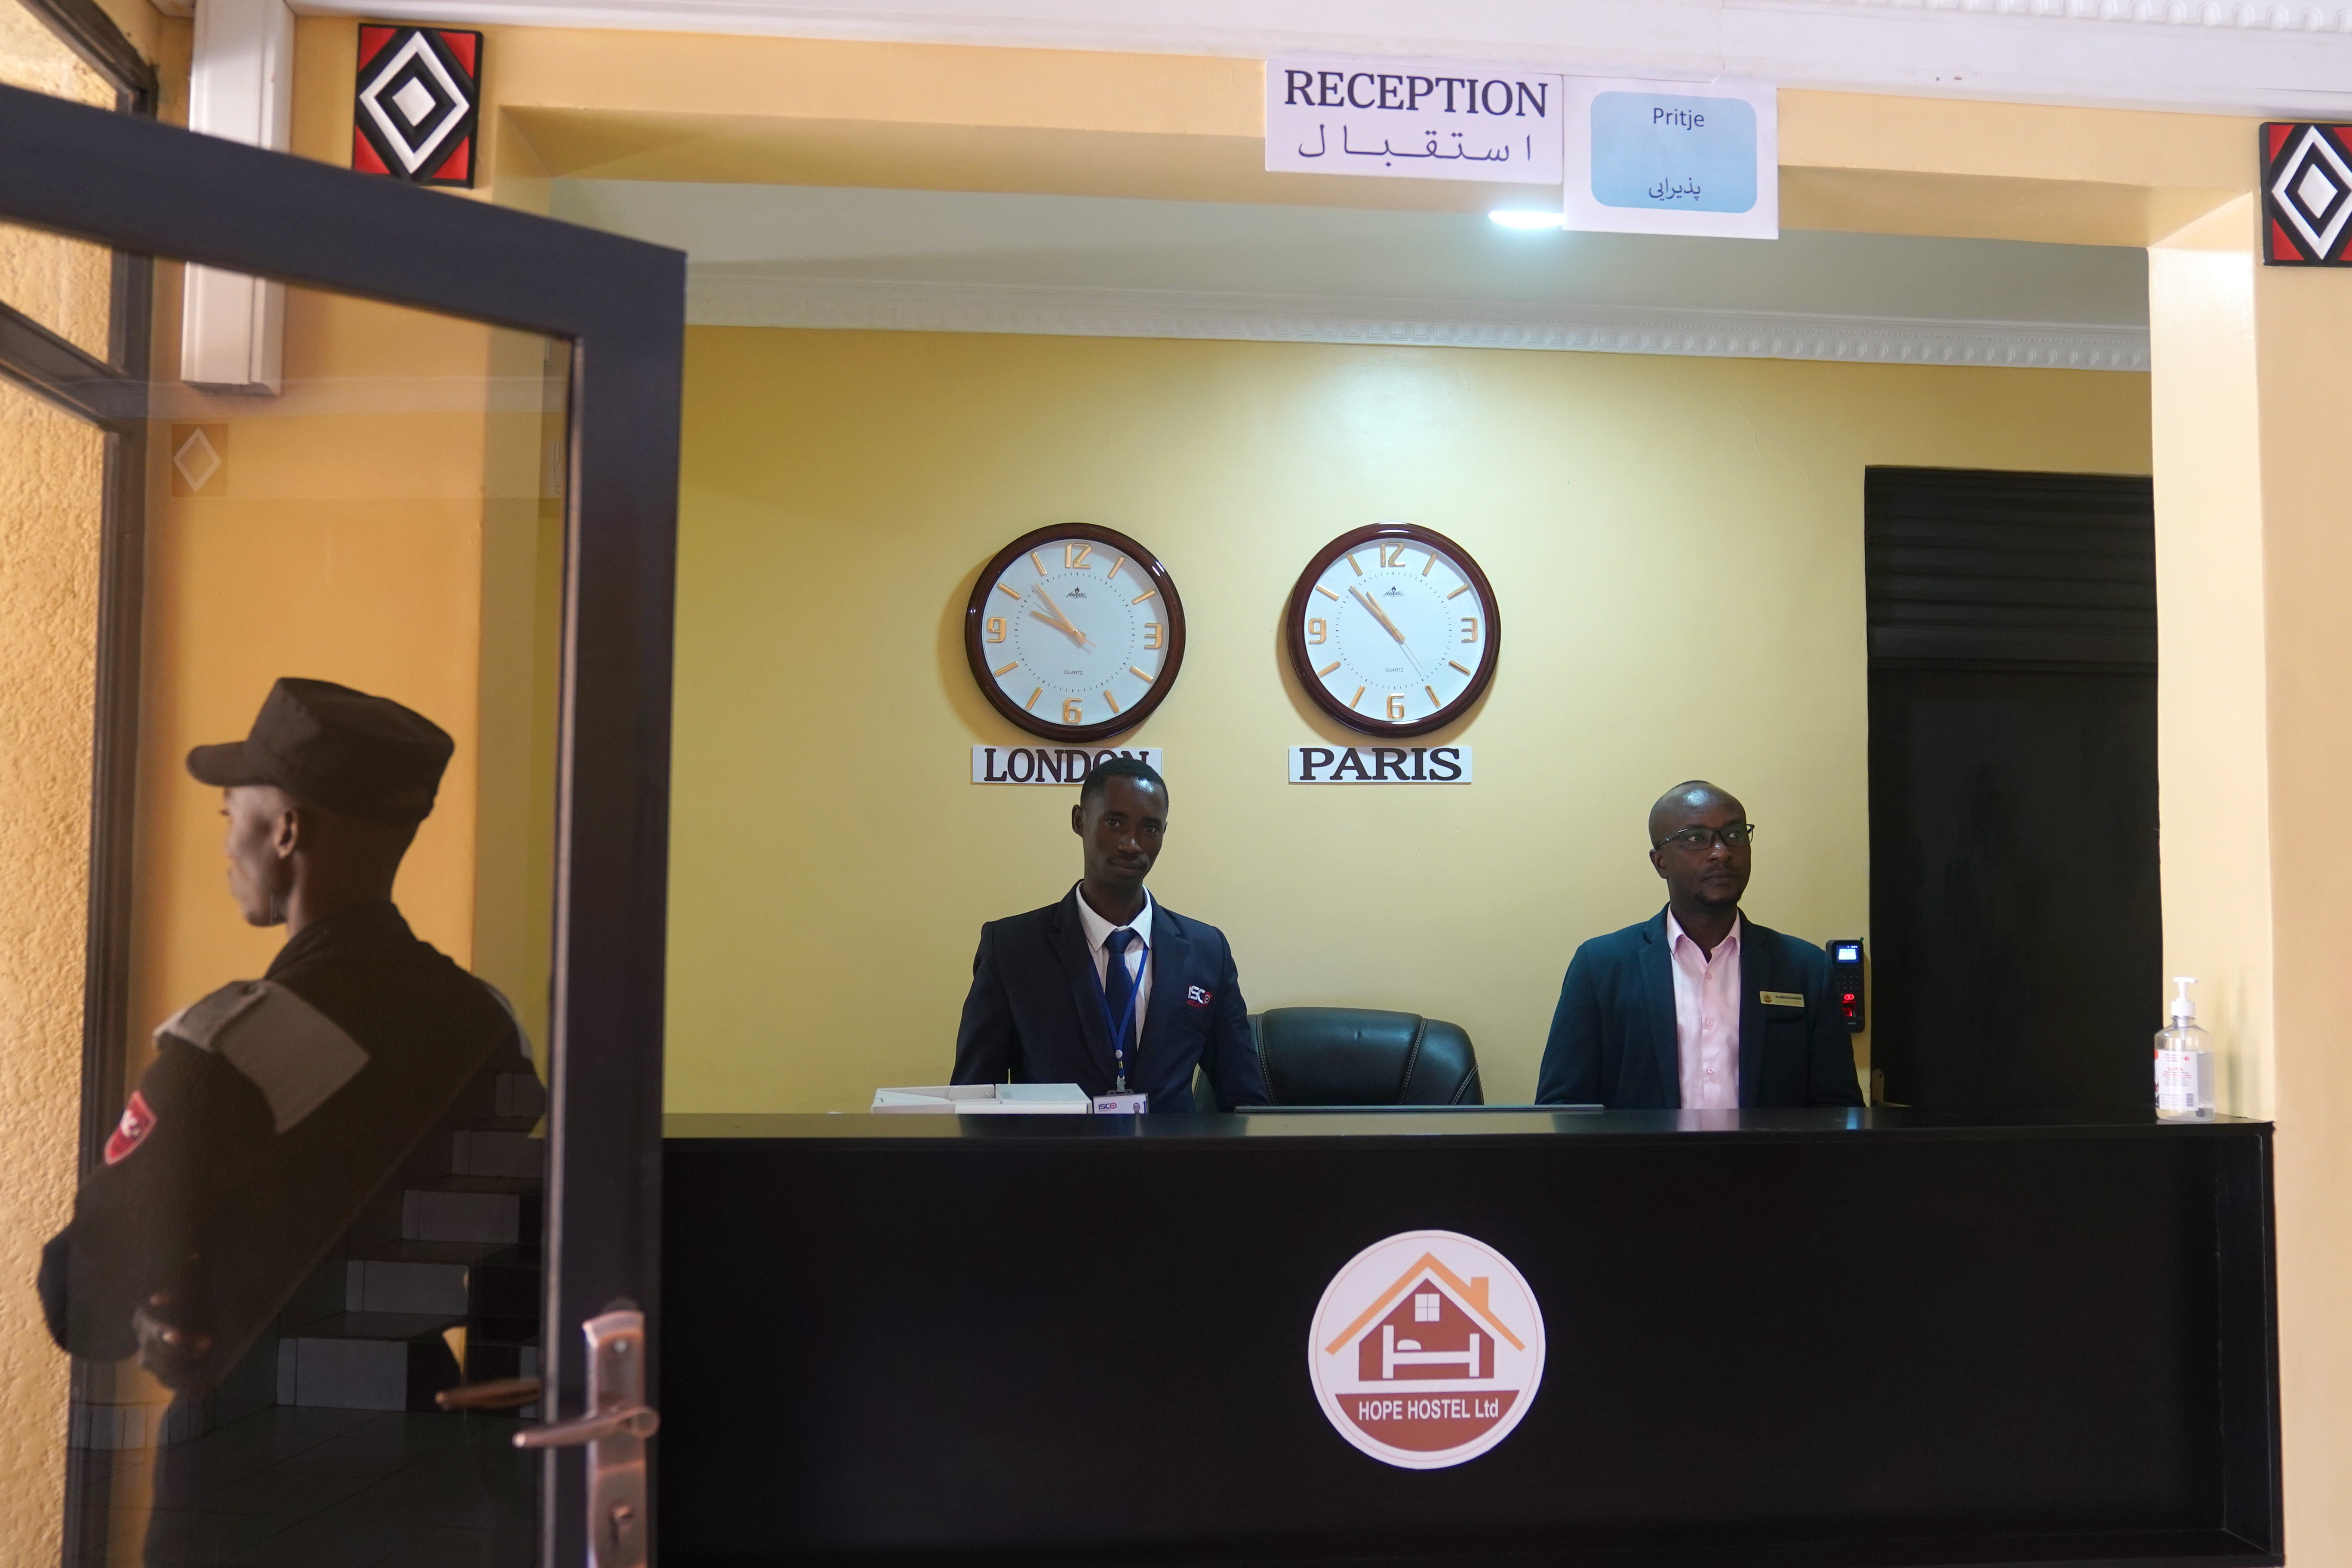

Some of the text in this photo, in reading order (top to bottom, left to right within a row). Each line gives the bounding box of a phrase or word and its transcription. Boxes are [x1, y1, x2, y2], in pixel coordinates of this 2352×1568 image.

[1284, 70, 1548, 117] RECEPTION
[1653, 108, 1705, 130] Pritje
[1298, 123, 1531, 167] استقبال
[1648, 177, 1701, 201] پذیرایی
[1064, 543, 1092, 569] 12
[1379, 542, 1406, 568] 12
[987, 617, 1007, 643] 9
[1144, 622, 1163, 649] 3
[1308, 617, 1328, 644] 9
[1460, 617, 1479, 643] 3
[1063, 697, 1083, 724] 6
[1386, 693, 1405, 719] 6
[1299, 747, 1462, 781] PARIS
[1358, 1398, 1499, 1421] HOPE HOSTEL Ltd
